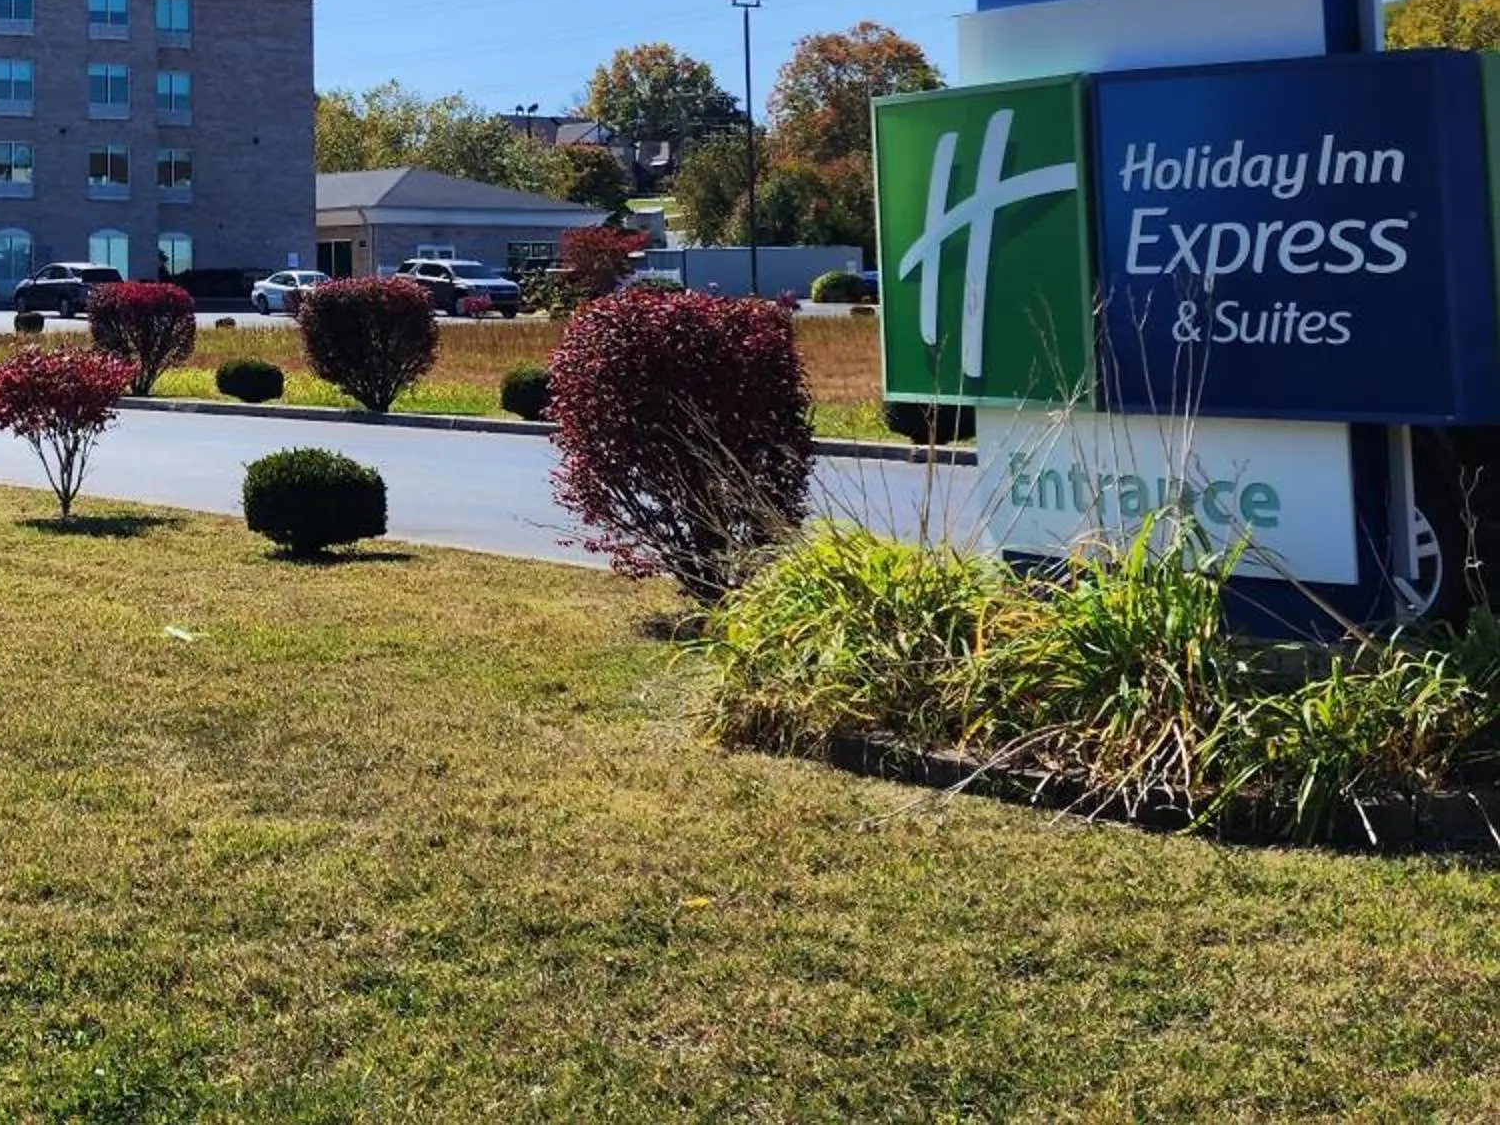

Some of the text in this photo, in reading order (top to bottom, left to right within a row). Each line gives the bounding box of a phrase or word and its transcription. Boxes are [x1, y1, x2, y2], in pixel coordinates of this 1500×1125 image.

[1120, 134, 1406, 200] Holiday Inn
[1125, 207, 1409, 294] Express
[1171, 300, 1353, 344] & Suites
